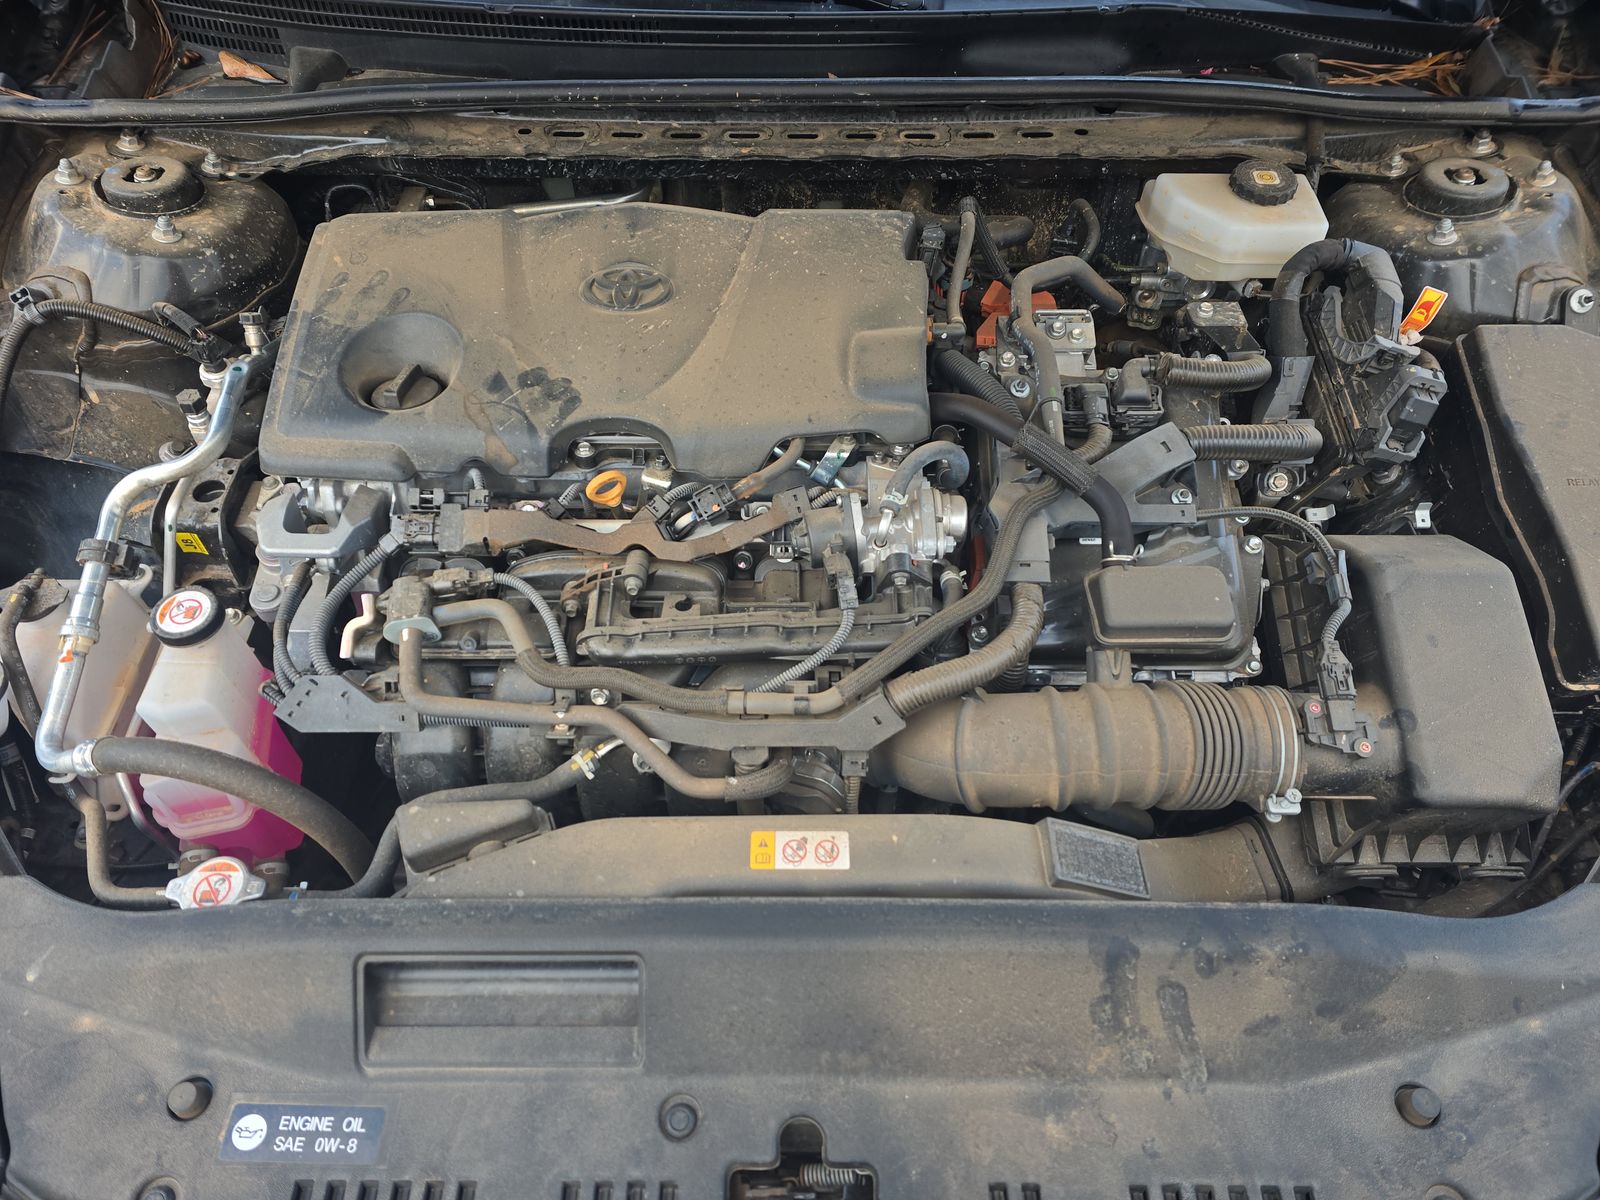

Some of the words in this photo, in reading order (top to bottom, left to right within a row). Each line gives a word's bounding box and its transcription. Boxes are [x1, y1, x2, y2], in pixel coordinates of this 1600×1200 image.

[279, 1115, 334, 1132] ENGINE
[342, 1116, 366, 1133] OIL
[273, 1136, 306, 1152] SAE
[314, 1137, 358, 1154] 0W-8
